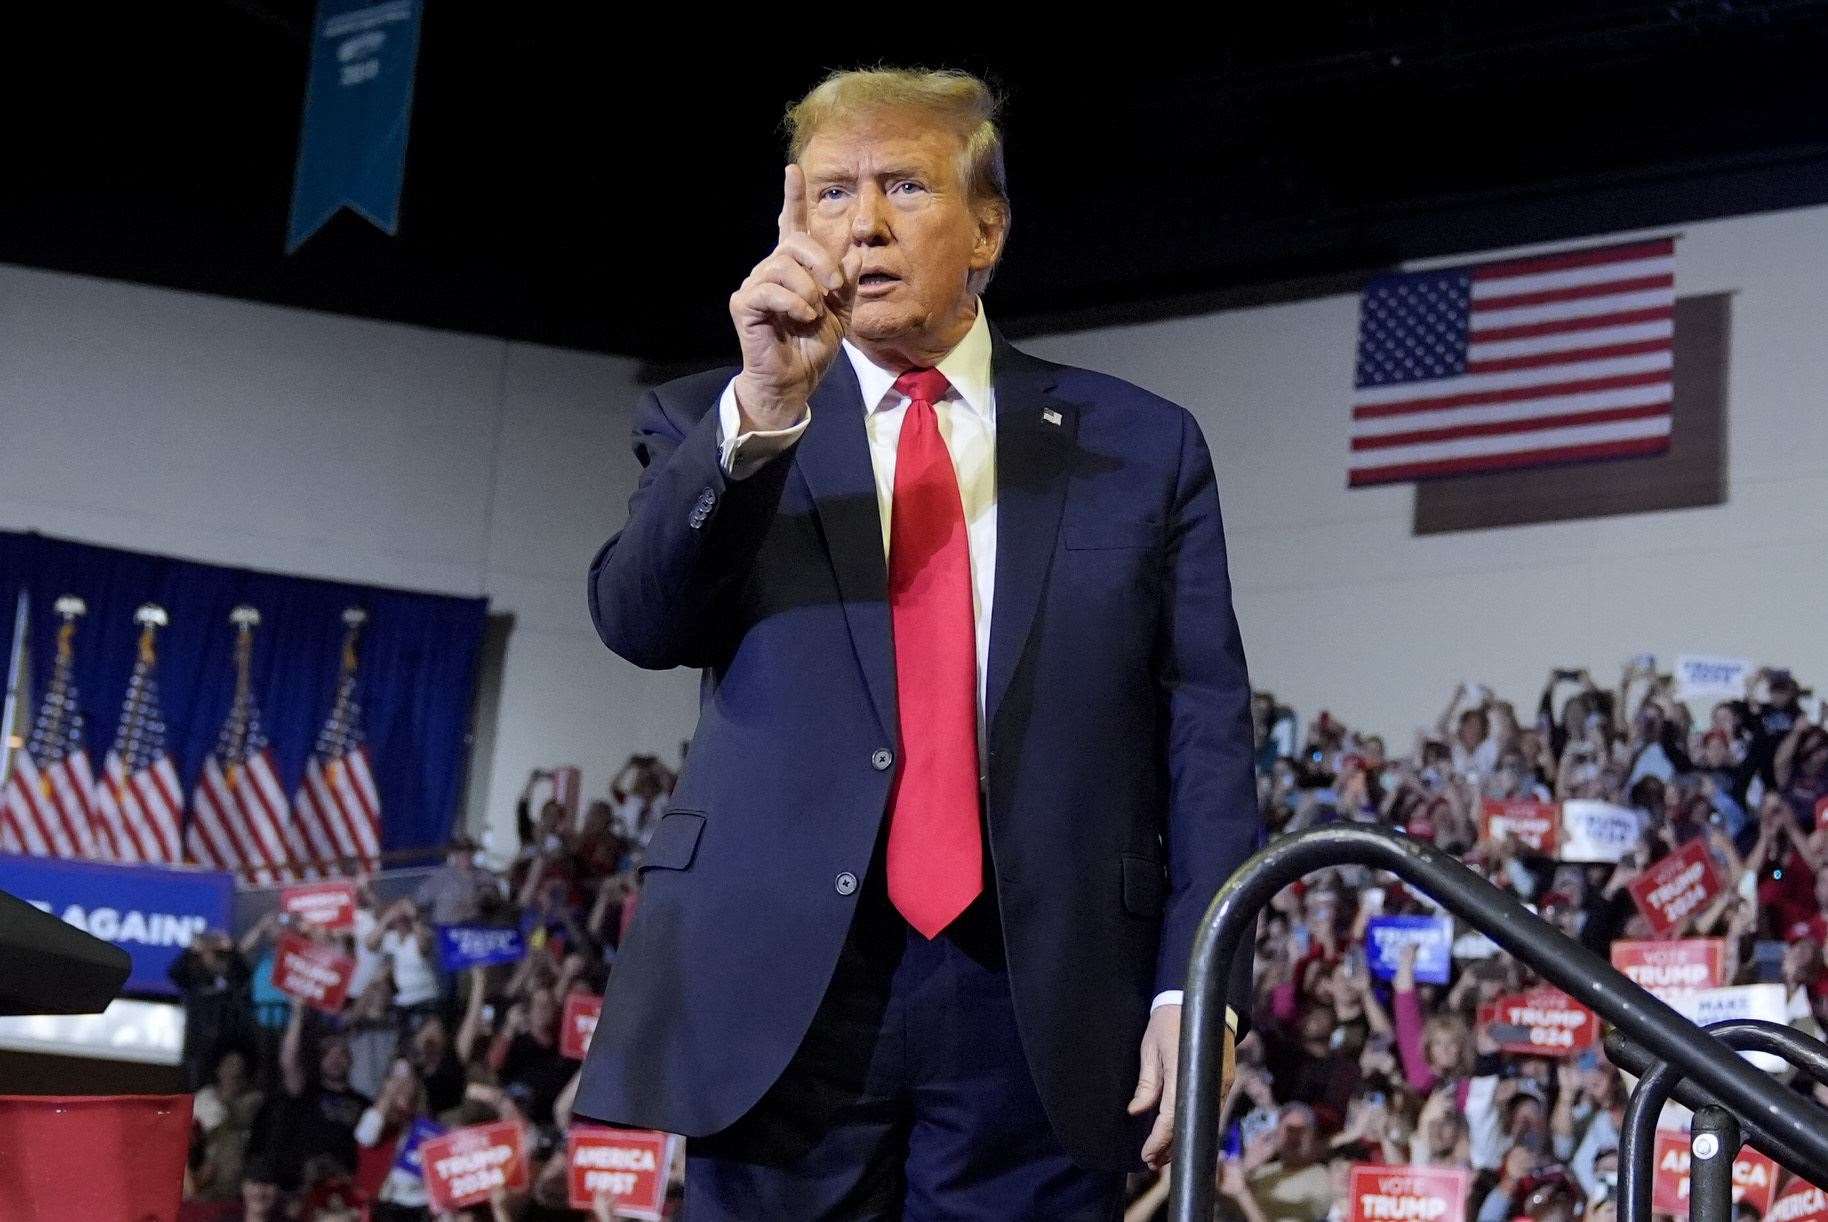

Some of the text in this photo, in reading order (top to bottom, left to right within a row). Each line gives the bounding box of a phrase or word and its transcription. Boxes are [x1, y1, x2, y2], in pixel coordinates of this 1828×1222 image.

[1624, 963, 1708, 985] TRUMP
[1508, 1006, 1586, 1029] TRUMP
[1528, 1026, 1574, 1048] 024
[435, 1144, 513, 1179] TRUMP
[573, 1146, 656, 1170] AMERICA
[584, 1170, 638, 1195] FIRST
[1360, 1193, 1447, 1220] TRUMP
